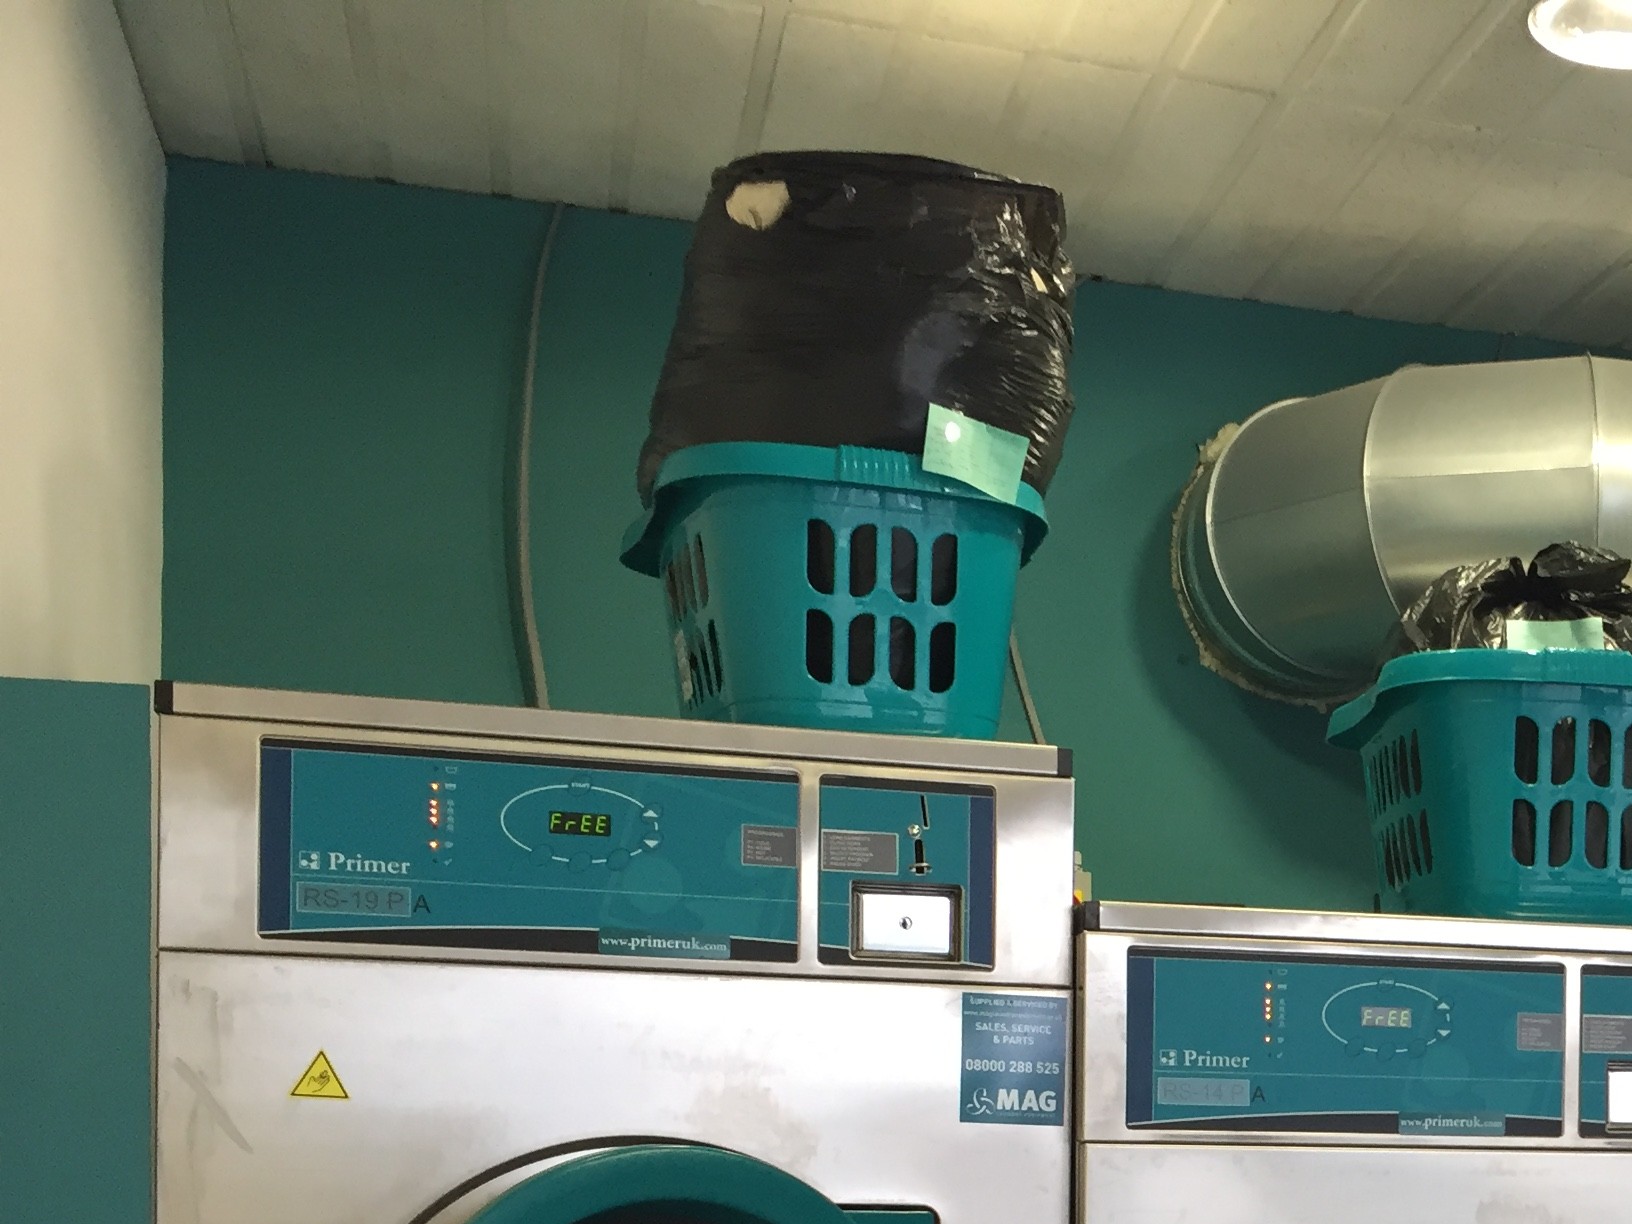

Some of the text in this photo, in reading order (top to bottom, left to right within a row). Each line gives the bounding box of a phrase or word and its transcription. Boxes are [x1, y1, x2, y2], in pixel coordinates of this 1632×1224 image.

[328, 852, 411, 874] Primer
[303, 887, 431, 914] RS-19 P A
[601, 935, 727, 951] www.primeruk.com
[975, 1022, 1051, 1035] SALES, SERVICE
[993, 1035, 1034, 1046] & PARTS
[965, 1059, 1060, 1075] 08000 288 525
[1183, 1049, 1250, 1068] Primer
[997, 1088, 1056, 1112] MAG
[1163, 1082, 1223, 1100] RS-14
[1251, 1086, 1266, 1102] A
[1400, 1114, 1502, 1130] www.primeruk.com
